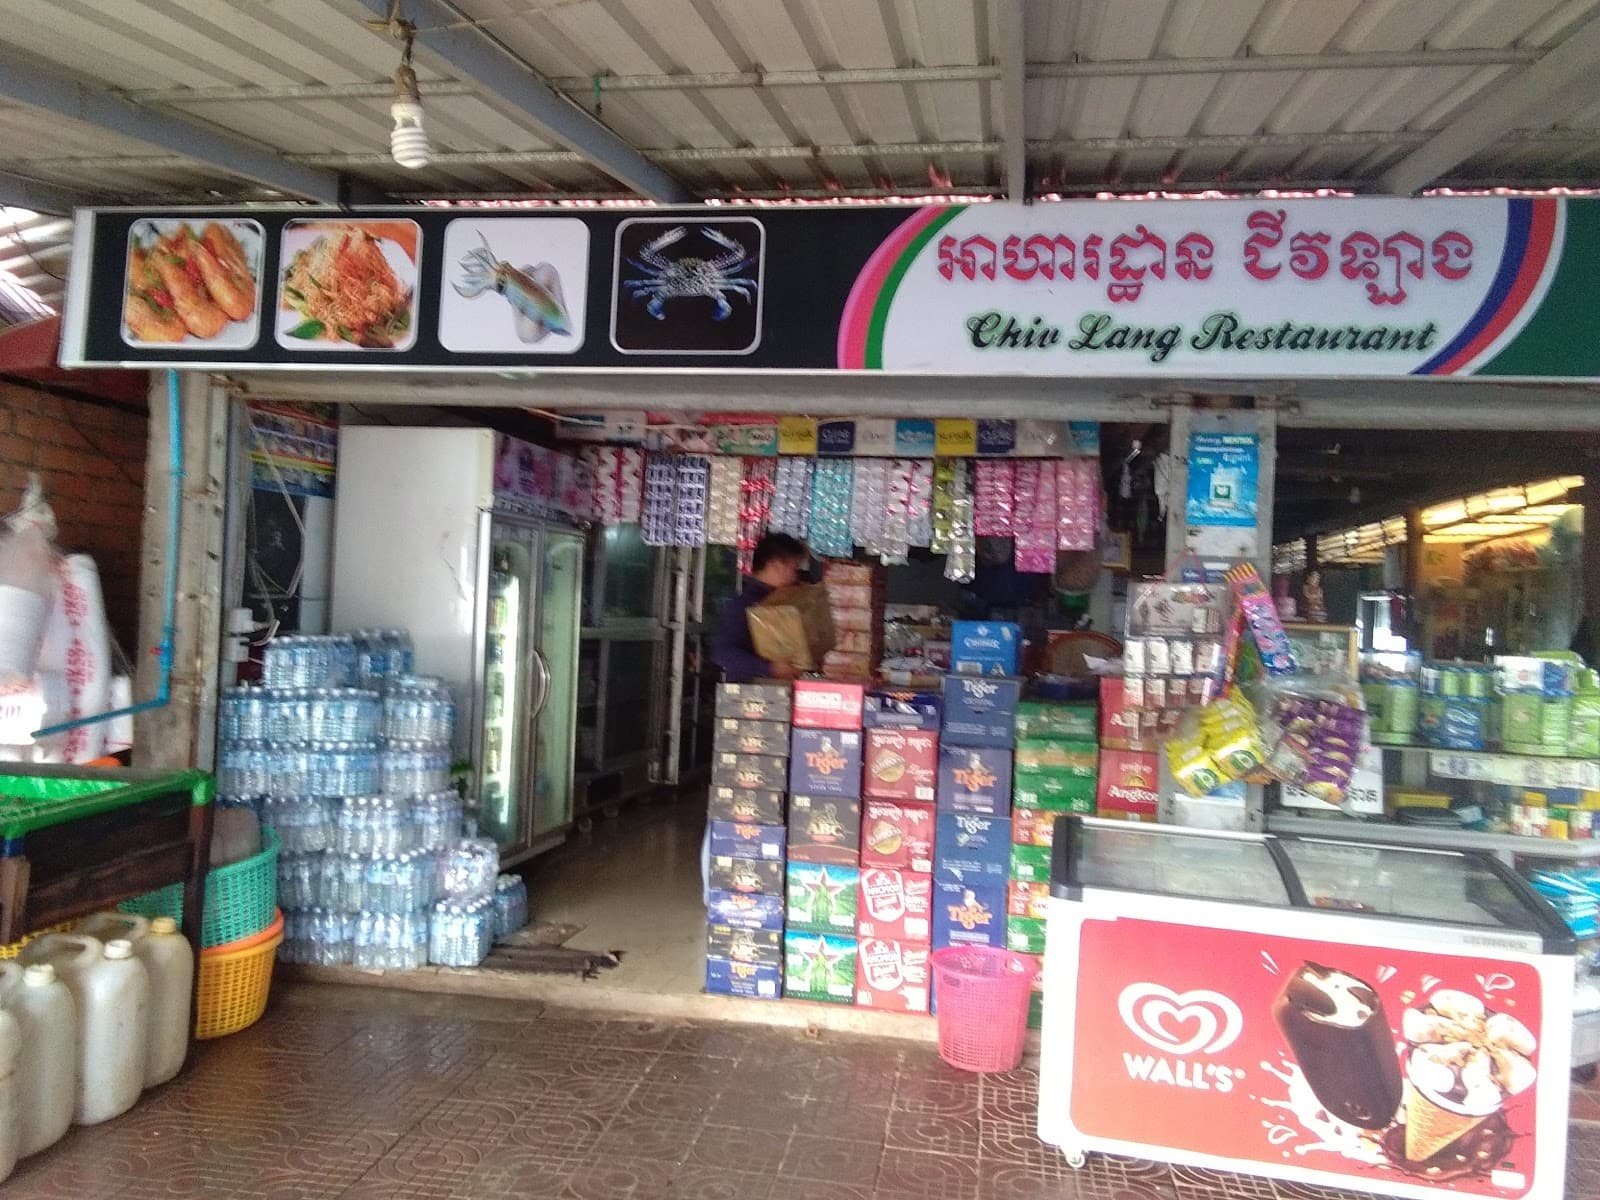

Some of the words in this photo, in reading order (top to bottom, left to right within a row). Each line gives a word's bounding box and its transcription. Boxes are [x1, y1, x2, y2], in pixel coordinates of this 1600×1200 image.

[966, 311, 1059, 348] Chiv
[1068, 313, 1187, 362] Lang
[1190, 311, 1437, 351] Restaurant
[805, 752, 848, 775] Tiger
[953, 768, 998, 793] Tiger
[947, 905, 993, 929] Tiger
[1122, 1052, 1235, 1093] WALL'S
